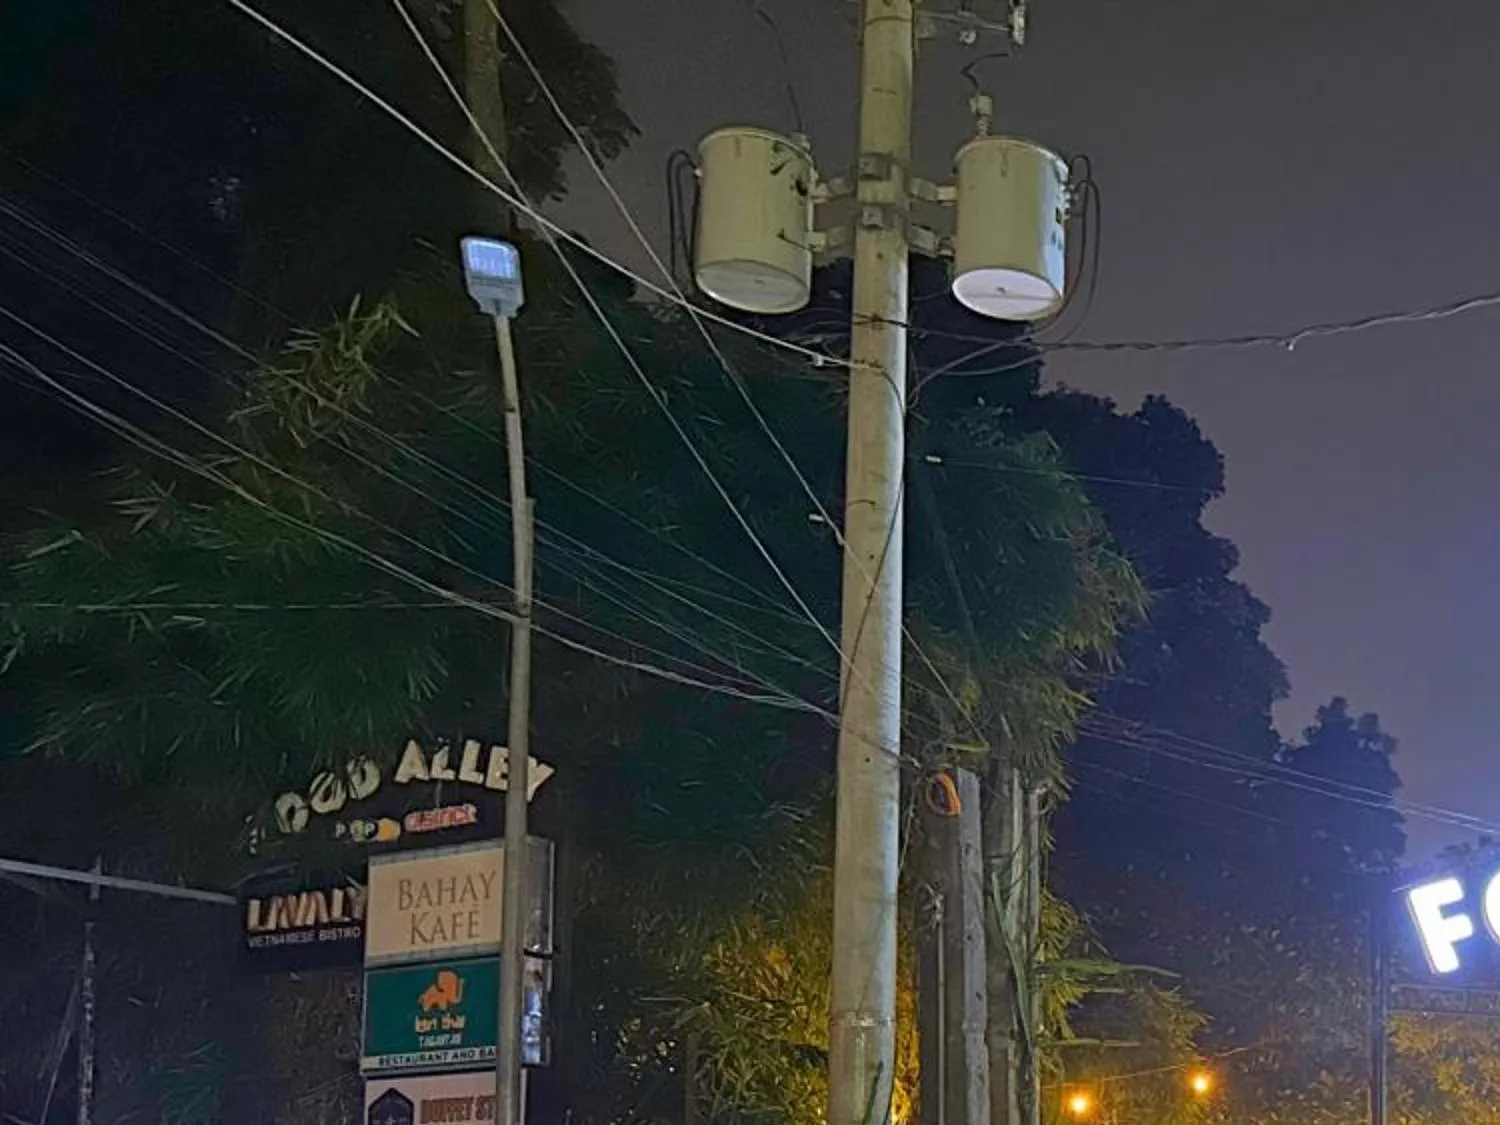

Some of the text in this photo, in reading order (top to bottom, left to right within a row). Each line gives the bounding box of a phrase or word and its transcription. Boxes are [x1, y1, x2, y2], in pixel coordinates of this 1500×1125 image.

[398, 869, 496, 911] BAHAY
[318, 926, 361, 941] BISTRO
[410, 908, 480, 945] KAFE
[378, 1047, 496, 1067] RESTAURANT AND BA
